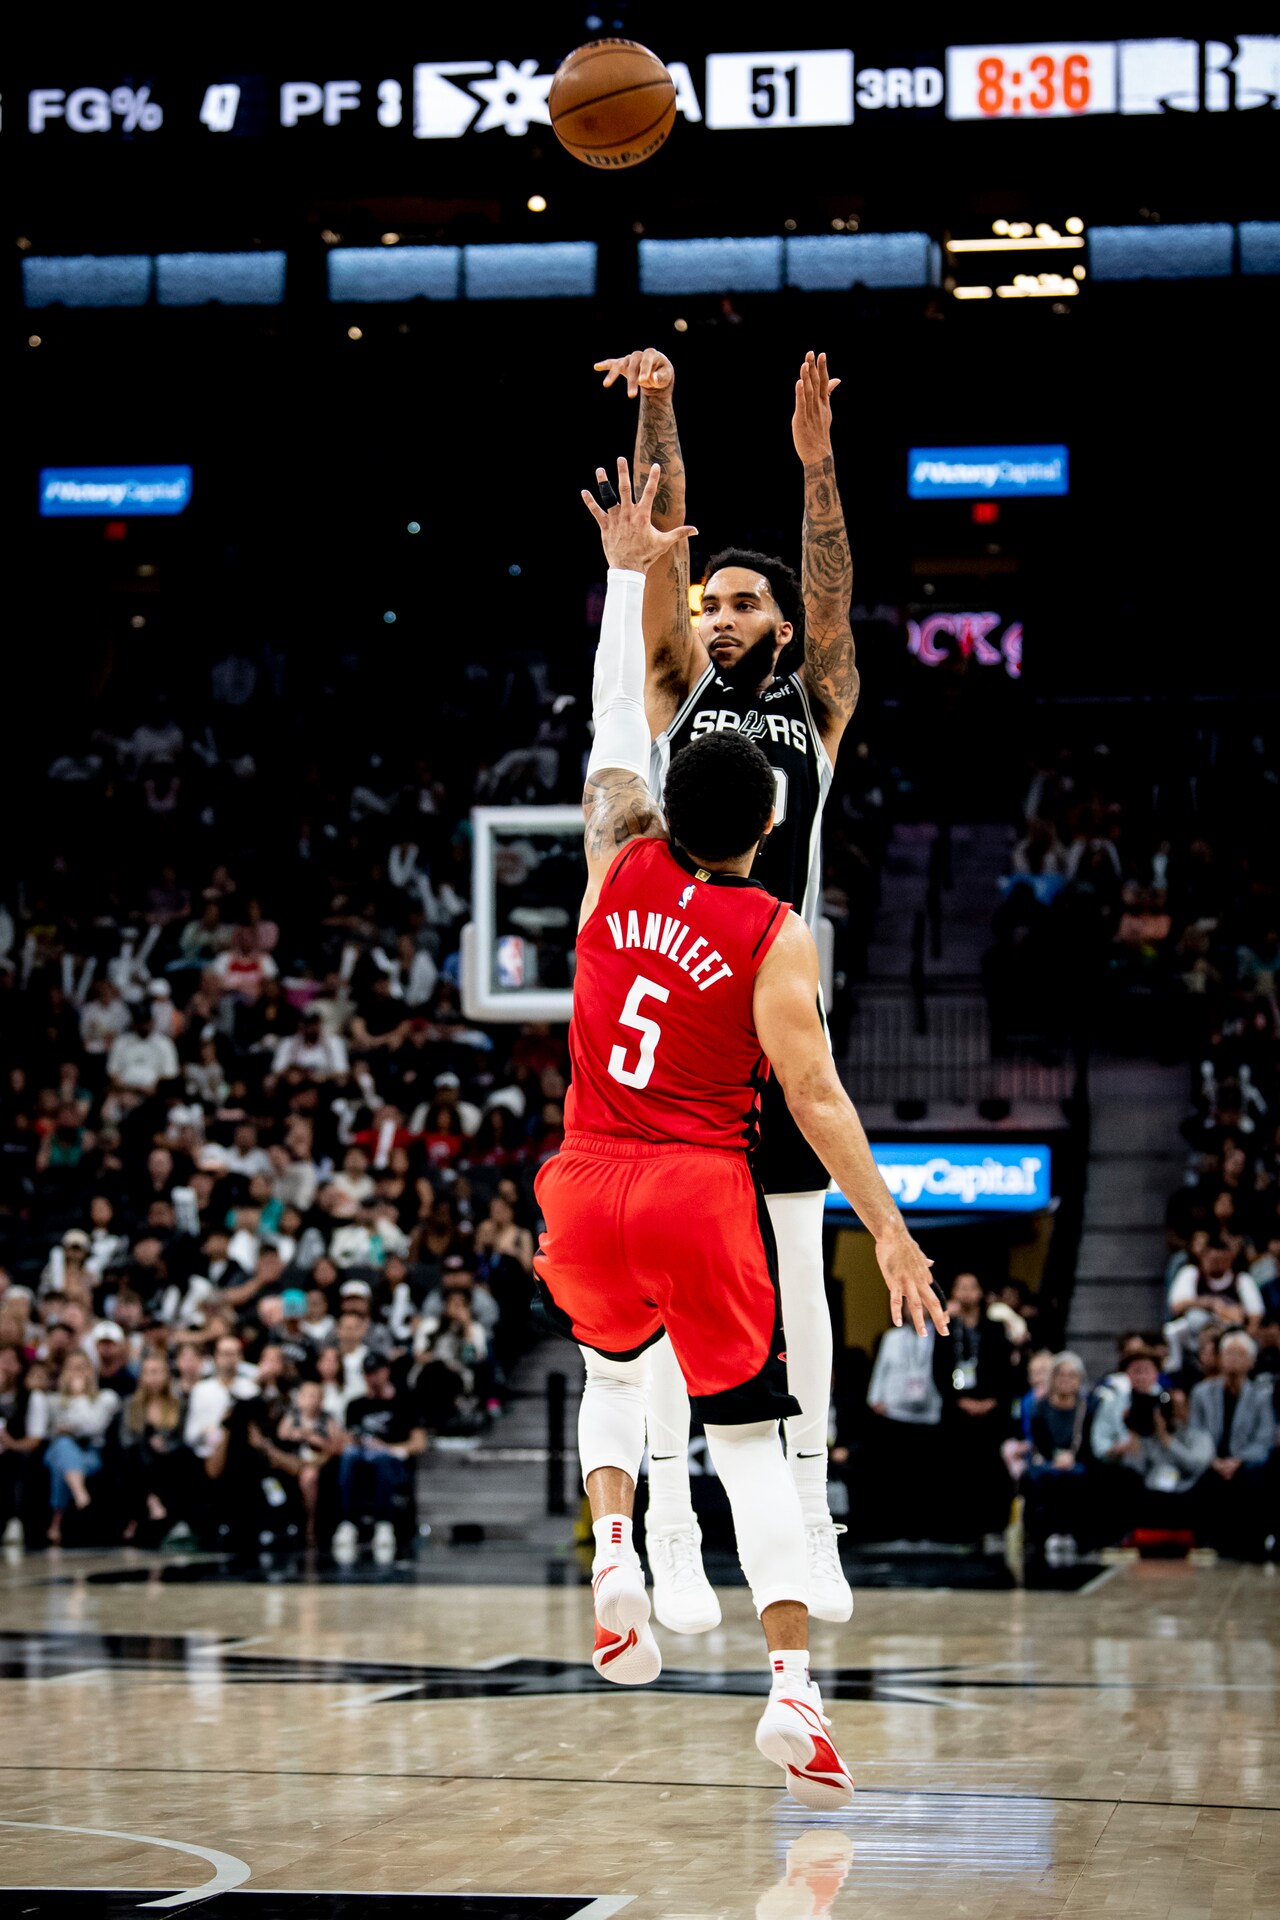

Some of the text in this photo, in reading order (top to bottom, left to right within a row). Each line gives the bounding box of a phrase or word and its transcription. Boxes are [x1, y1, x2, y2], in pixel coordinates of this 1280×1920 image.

[29, 86, 164, 134] FG%
[280, 80, 362, 127] PF
[752, 65, 798, 119] 51
[856, 66, 944, 110] 3RD
[978, 54, 1090, 115] 8:36
[605, 909, 734, 992] VANVLEET
[607, 974, 671, 1090] 5
